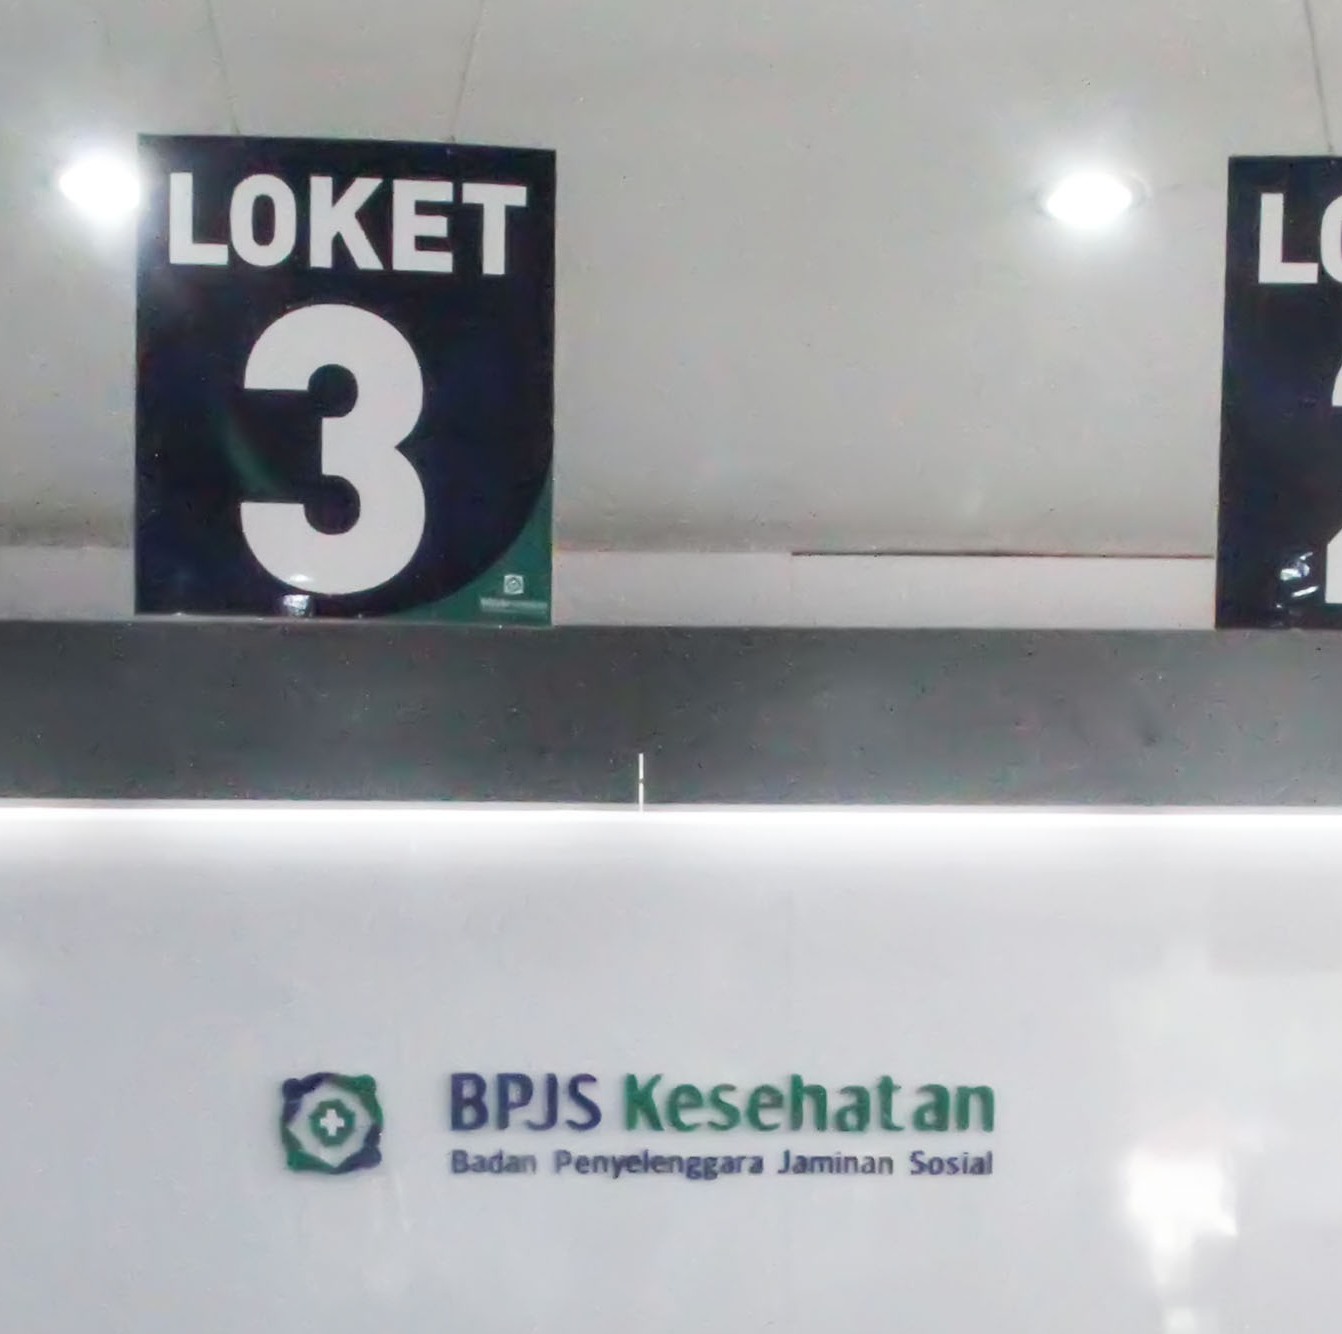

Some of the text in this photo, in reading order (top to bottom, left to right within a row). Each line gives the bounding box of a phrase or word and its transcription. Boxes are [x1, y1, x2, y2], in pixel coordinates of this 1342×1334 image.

[169, 172, 527, 275] LOKET
[241, 304, 425, 595] 3
[450, 1073, 994, 1133] BPJS Kesehatan
[451, 1150, 993, 1180] Badan Penyelenggara Jaminan Sosial
